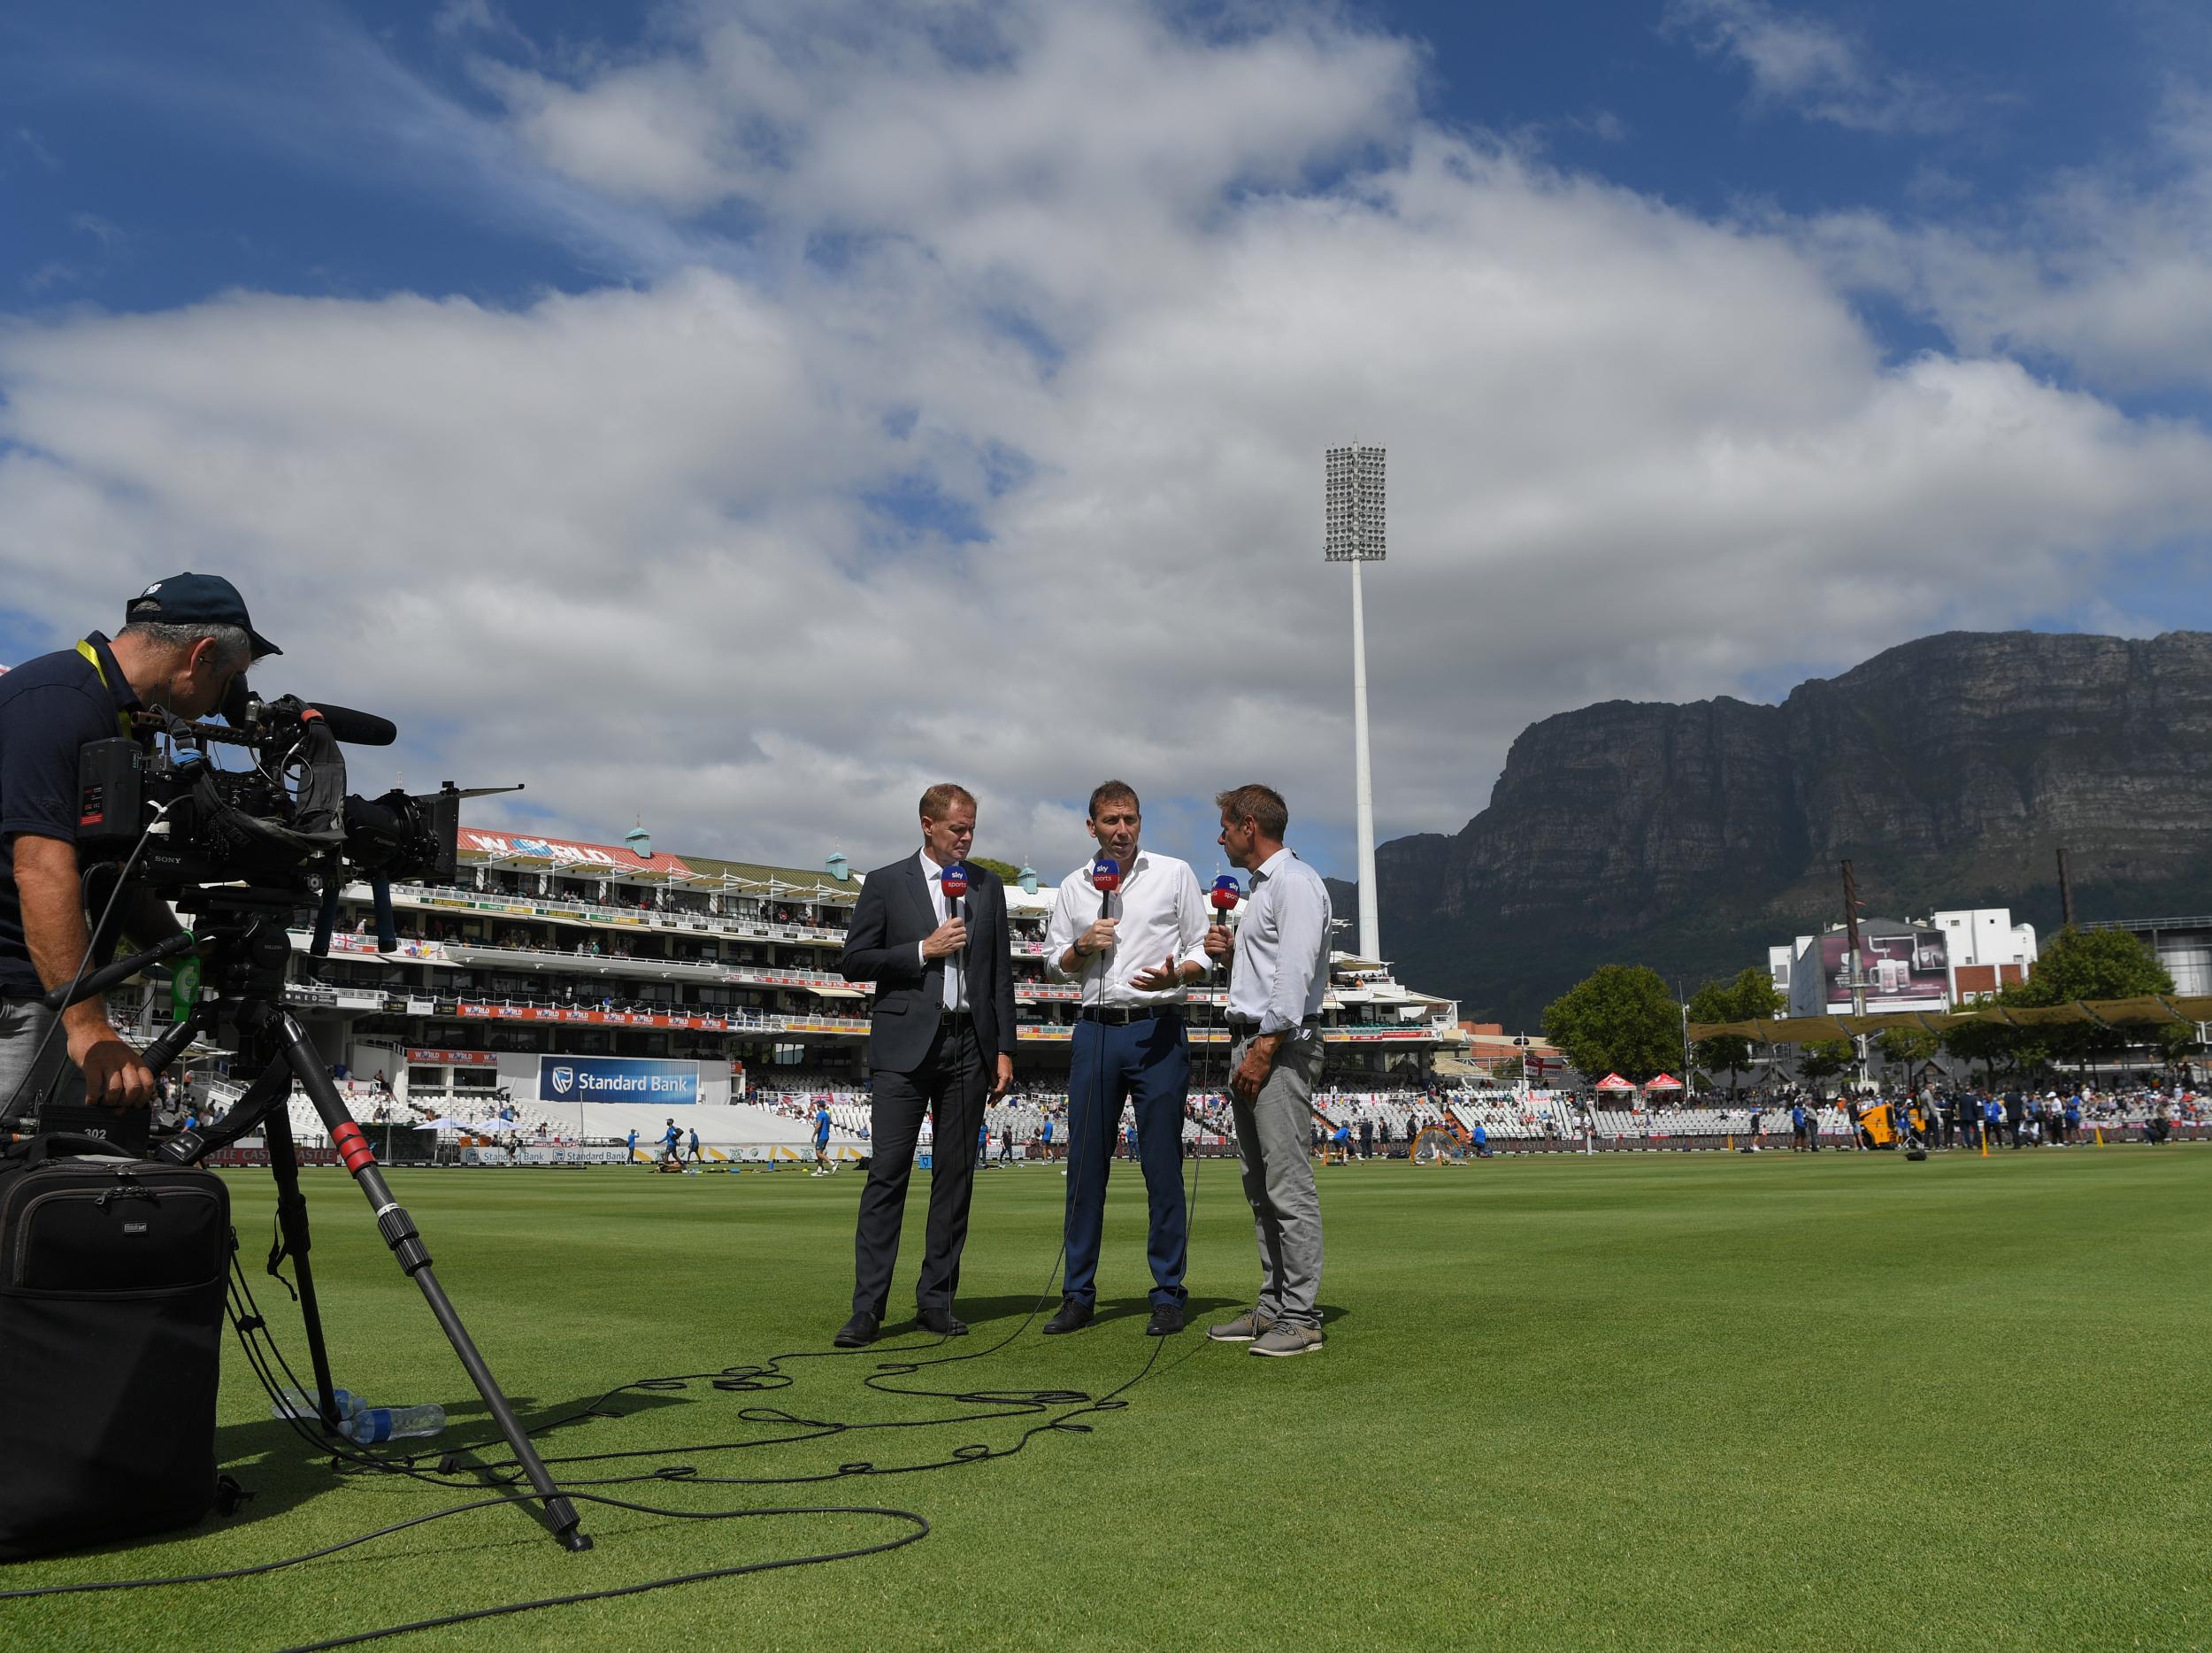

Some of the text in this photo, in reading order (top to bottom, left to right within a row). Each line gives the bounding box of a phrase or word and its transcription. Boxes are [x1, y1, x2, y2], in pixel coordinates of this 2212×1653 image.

[579, 1073, 687, 1091] Standard Bank
[85, 1128, 107, 1140] 302
[1592, 1139, 1617, 1148] ASTLE
[567, 1151, 626, 1161] Standard Bank
